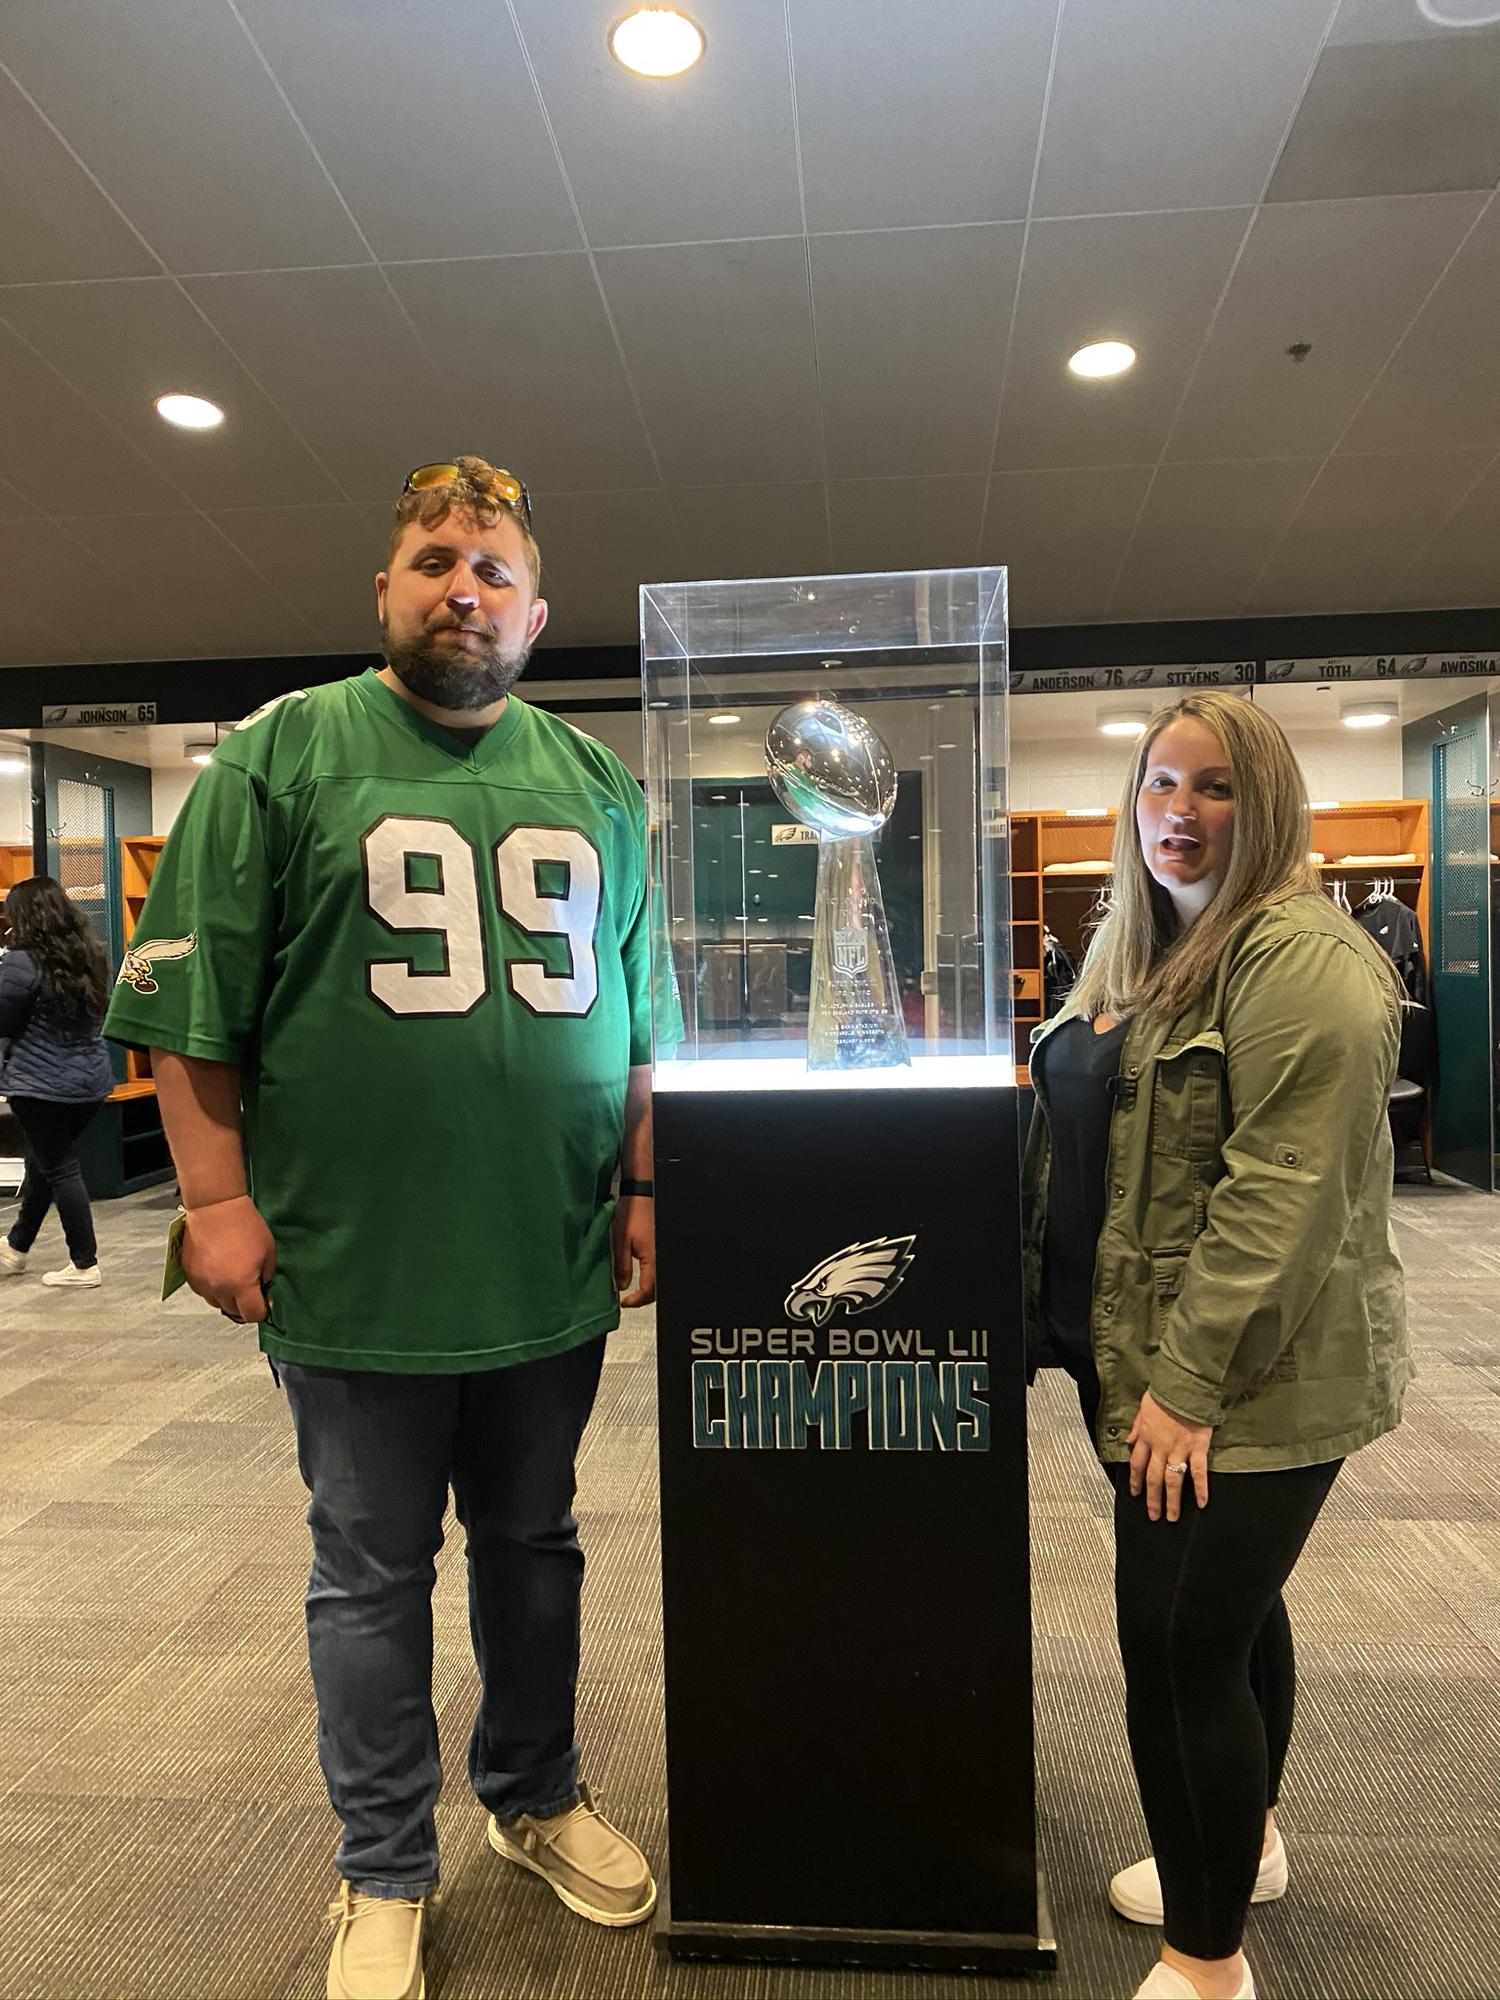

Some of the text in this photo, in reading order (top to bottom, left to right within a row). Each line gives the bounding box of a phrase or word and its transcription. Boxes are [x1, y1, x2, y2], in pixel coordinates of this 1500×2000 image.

[1166, 663, 1254, 684] STEVENS 30
[1317, 657, 1396, 677] TOTH 64
[1440, 659, 1496, 674] AWOSIKA
[1032, 668, 1123, 690] ANDERSON 76
[79, 704, 155, 724] JOHNSON 65
[360, 812, 604, 1021] 99
[837, 945, 866, 969] NFL
[690, 1328, 989, 1358] SUPER BOWL LII
[691, 1360, 991, 1452] CHAMPIONS
